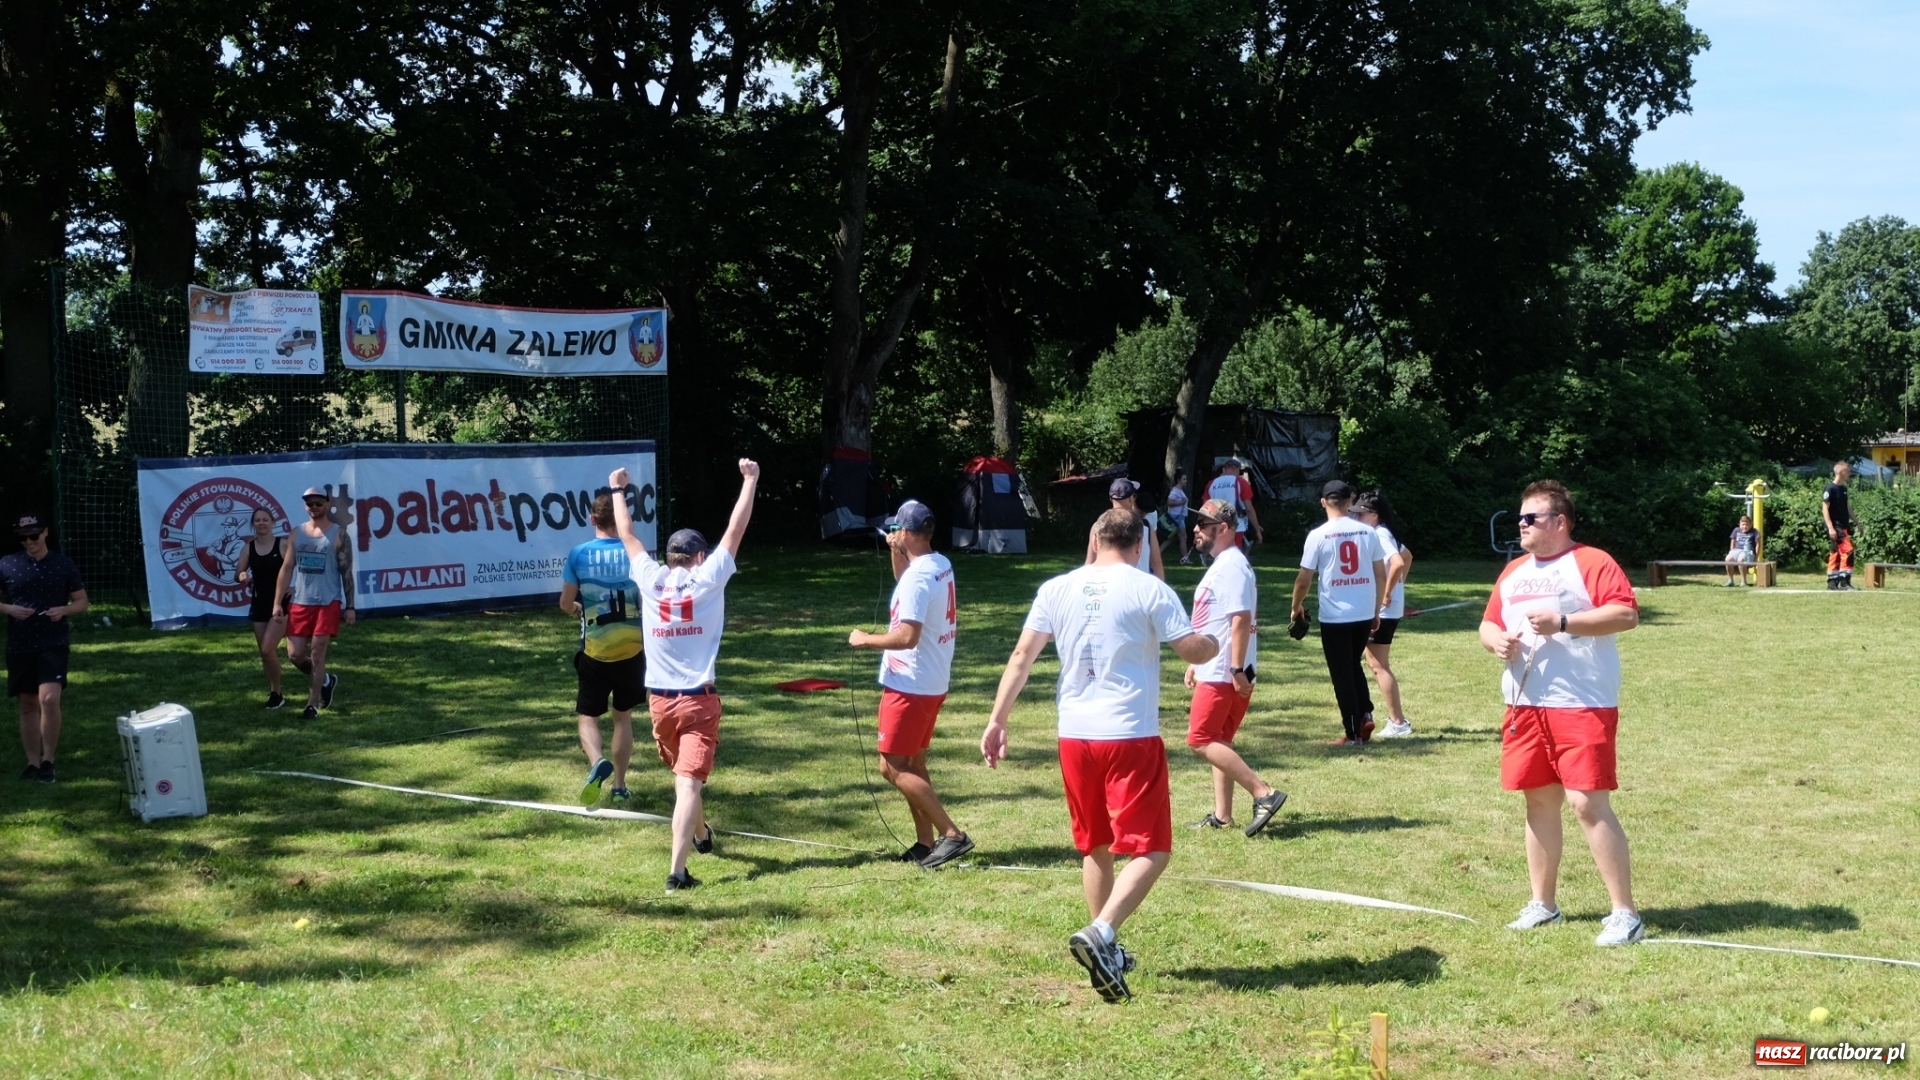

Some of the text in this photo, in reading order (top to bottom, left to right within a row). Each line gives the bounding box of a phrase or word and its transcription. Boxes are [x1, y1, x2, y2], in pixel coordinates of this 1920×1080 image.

[399, 317, 617, 357] GMINA ZALEWO
[169, 484, 280, 526] POLSKIE STOWARZYSZENIE
[477, 559, 514, 574] ZNAJDŹ
[516, 560, 536, 571] NAS
[537, 558, 551, 569] NA
[1339, 540, 1359, 575] 9
[472, 574, 506, 584] POLSKIE
[1331, 576, 1370, 587] PSPal Kadra
[658, 594, 694, 623] 11
[946, 580, 956, 626] 4
[652, 625, 703, 638] PSPal Kadra
